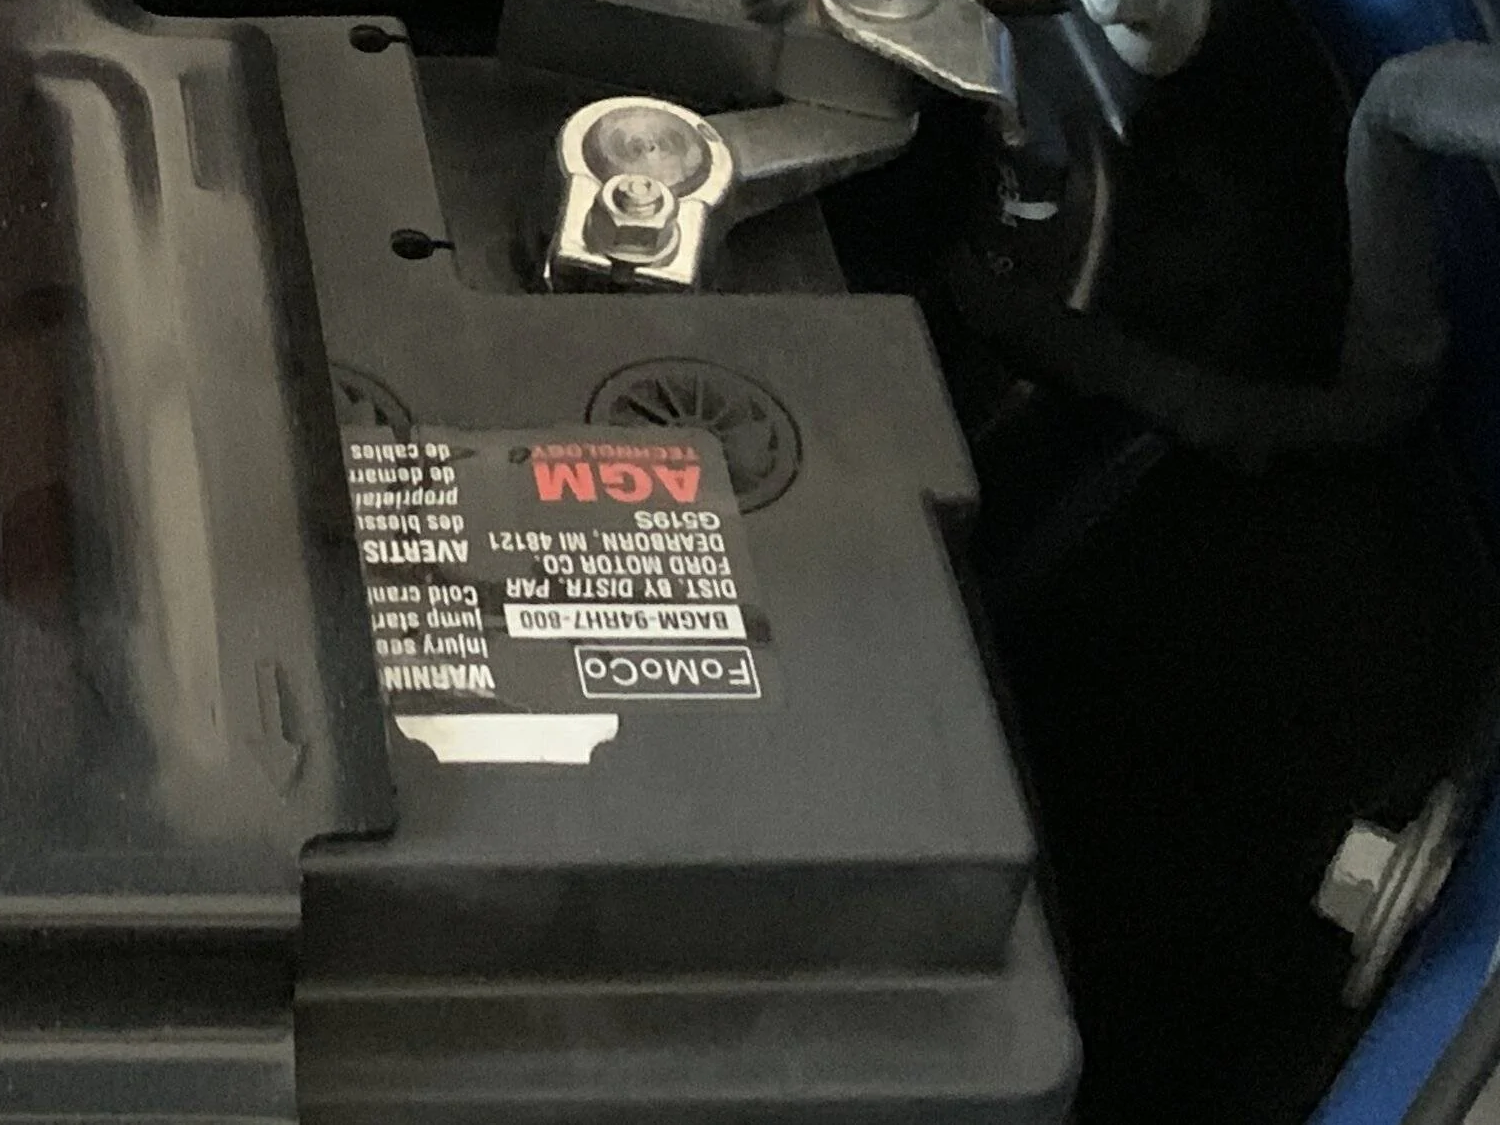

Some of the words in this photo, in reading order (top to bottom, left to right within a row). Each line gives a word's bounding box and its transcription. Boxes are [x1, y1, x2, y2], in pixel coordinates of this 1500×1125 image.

[350, 443, 418, 462] cables
[422, 443, 451, 462] de
[427, 465, 455, 485] de
[532, 461, 701, 503] AGM
[426, 514, 464, 535] des
[633, 510, 720, 529] G519S
[362, 539, 469, 563] AVERTIS
[487, 532, 551, 550] 48121
[559, 532, 585, 551] MI
[593, 529, 724, 552] DEARBORN,
[534, 553, 573, 573] CO.
[581, 554, 662, 574] MOTOR
[669, 554, 730, 575] FORD
[427, 584, 478, 606] Cold
[505, 577, 550, 598] PAR
[559, 577, 633, 598] DISTR.
[643, 578, 671, 598] BY
[679, 578, 736, 599] DIST.
[426, 607, 482, 631] jump
[519, 609, 727, 631] BAGM-94RH7-800
[423, 636, 488, 659] Injury
[377, 663, 494, 690] WARNIN
[583, 657, 750, 687] FoMoCo
